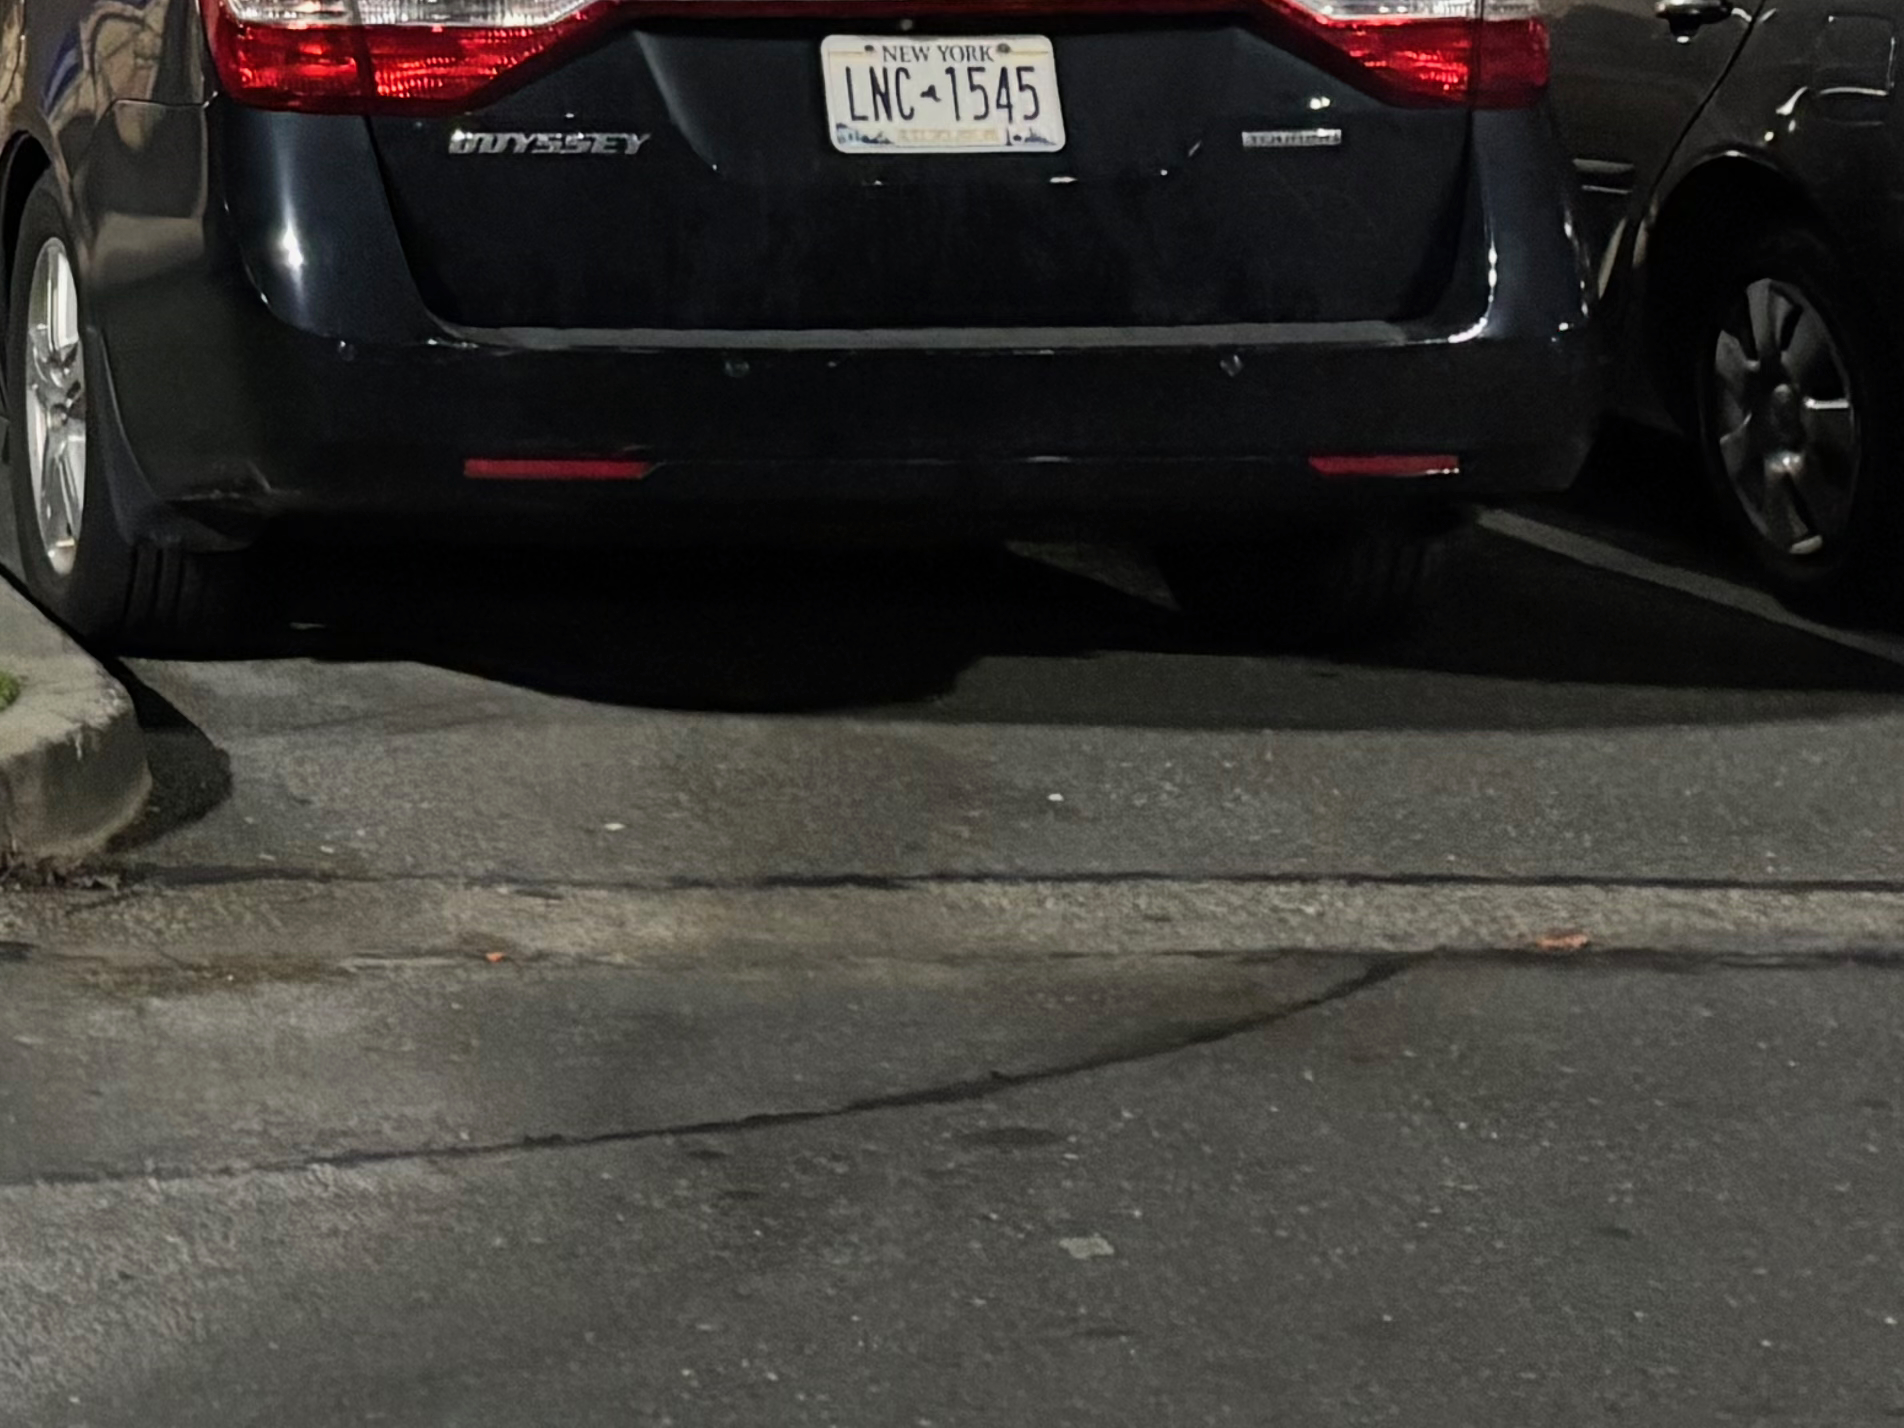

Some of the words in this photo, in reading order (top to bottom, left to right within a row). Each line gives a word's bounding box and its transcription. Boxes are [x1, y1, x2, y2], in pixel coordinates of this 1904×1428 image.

[882, 44, 931, 63] NEW
[939, 43, 996, 63] YORK
[845, 66, 915, 123] LNC
[944, 65, 1040, 124] 1545
[448, 130, 651, 155] ODYSSEY
